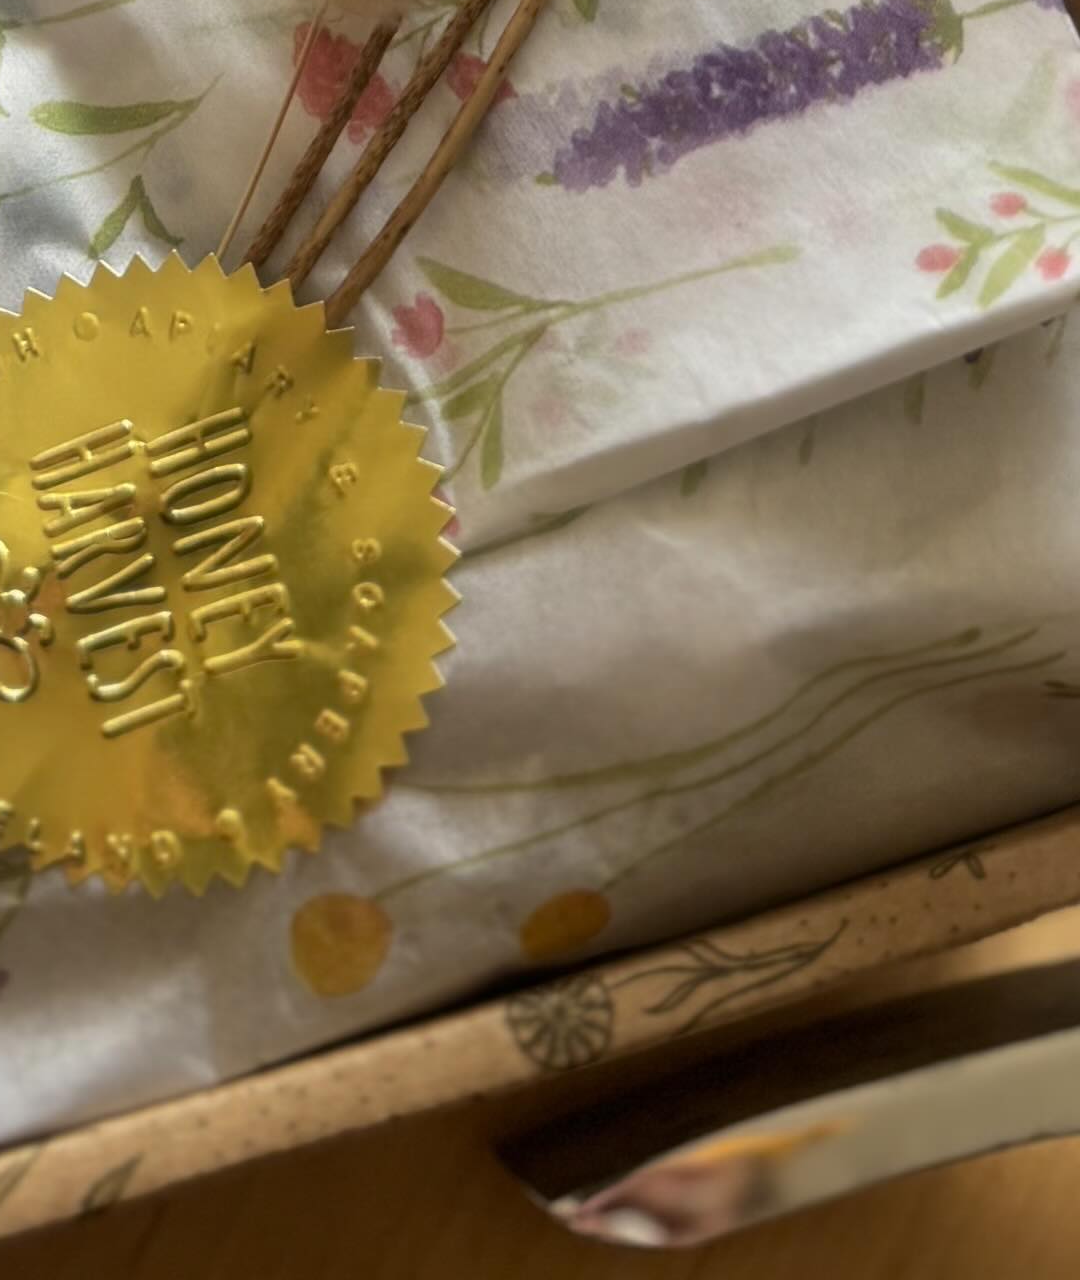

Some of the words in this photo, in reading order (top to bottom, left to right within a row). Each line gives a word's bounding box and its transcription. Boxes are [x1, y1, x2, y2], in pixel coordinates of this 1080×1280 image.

[30, 418, 197, 737] HARVEST
[146, 406, 305, 672] HONEY
[266, 537, 384, 800] SOAPERY
